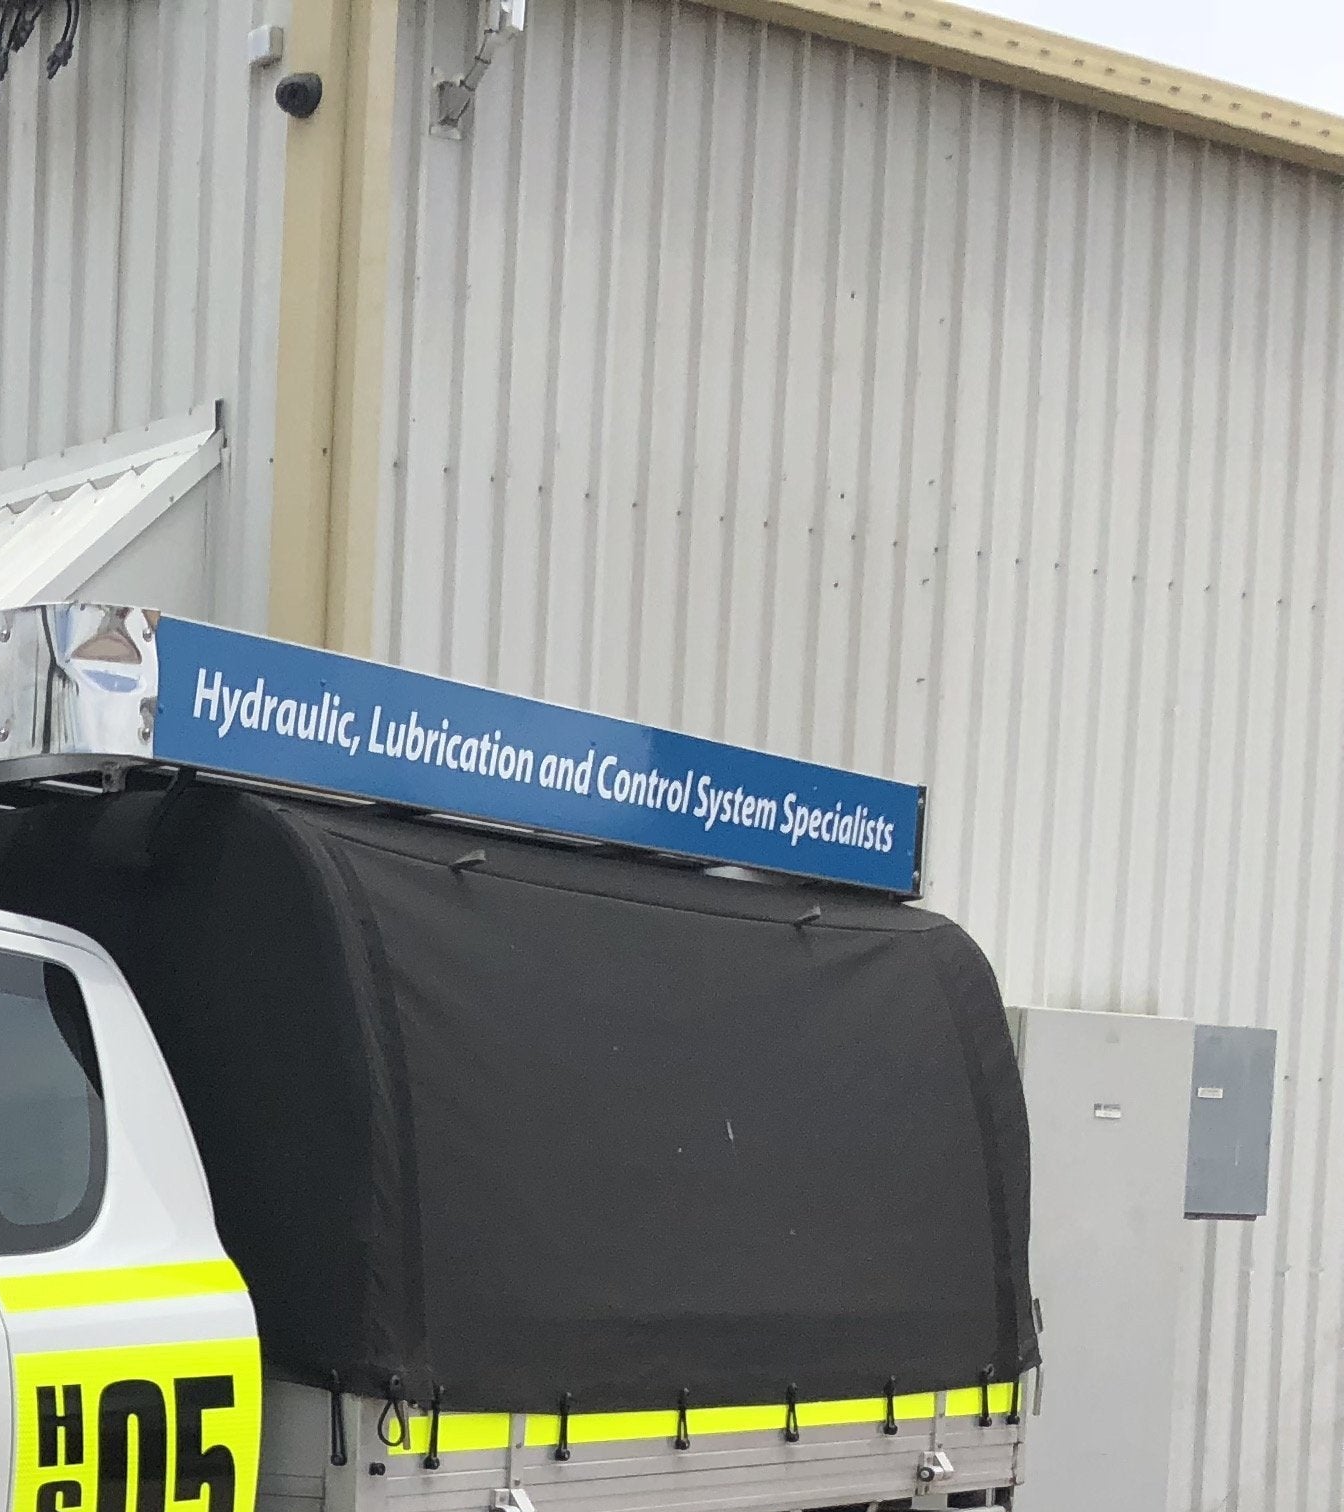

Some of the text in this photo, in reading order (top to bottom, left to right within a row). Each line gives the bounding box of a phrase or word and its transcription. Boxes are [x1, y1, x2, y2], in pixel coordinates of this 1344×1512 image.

[193, 668, 896, 853] Hydraulic, Lubrication and Control System Specialists
